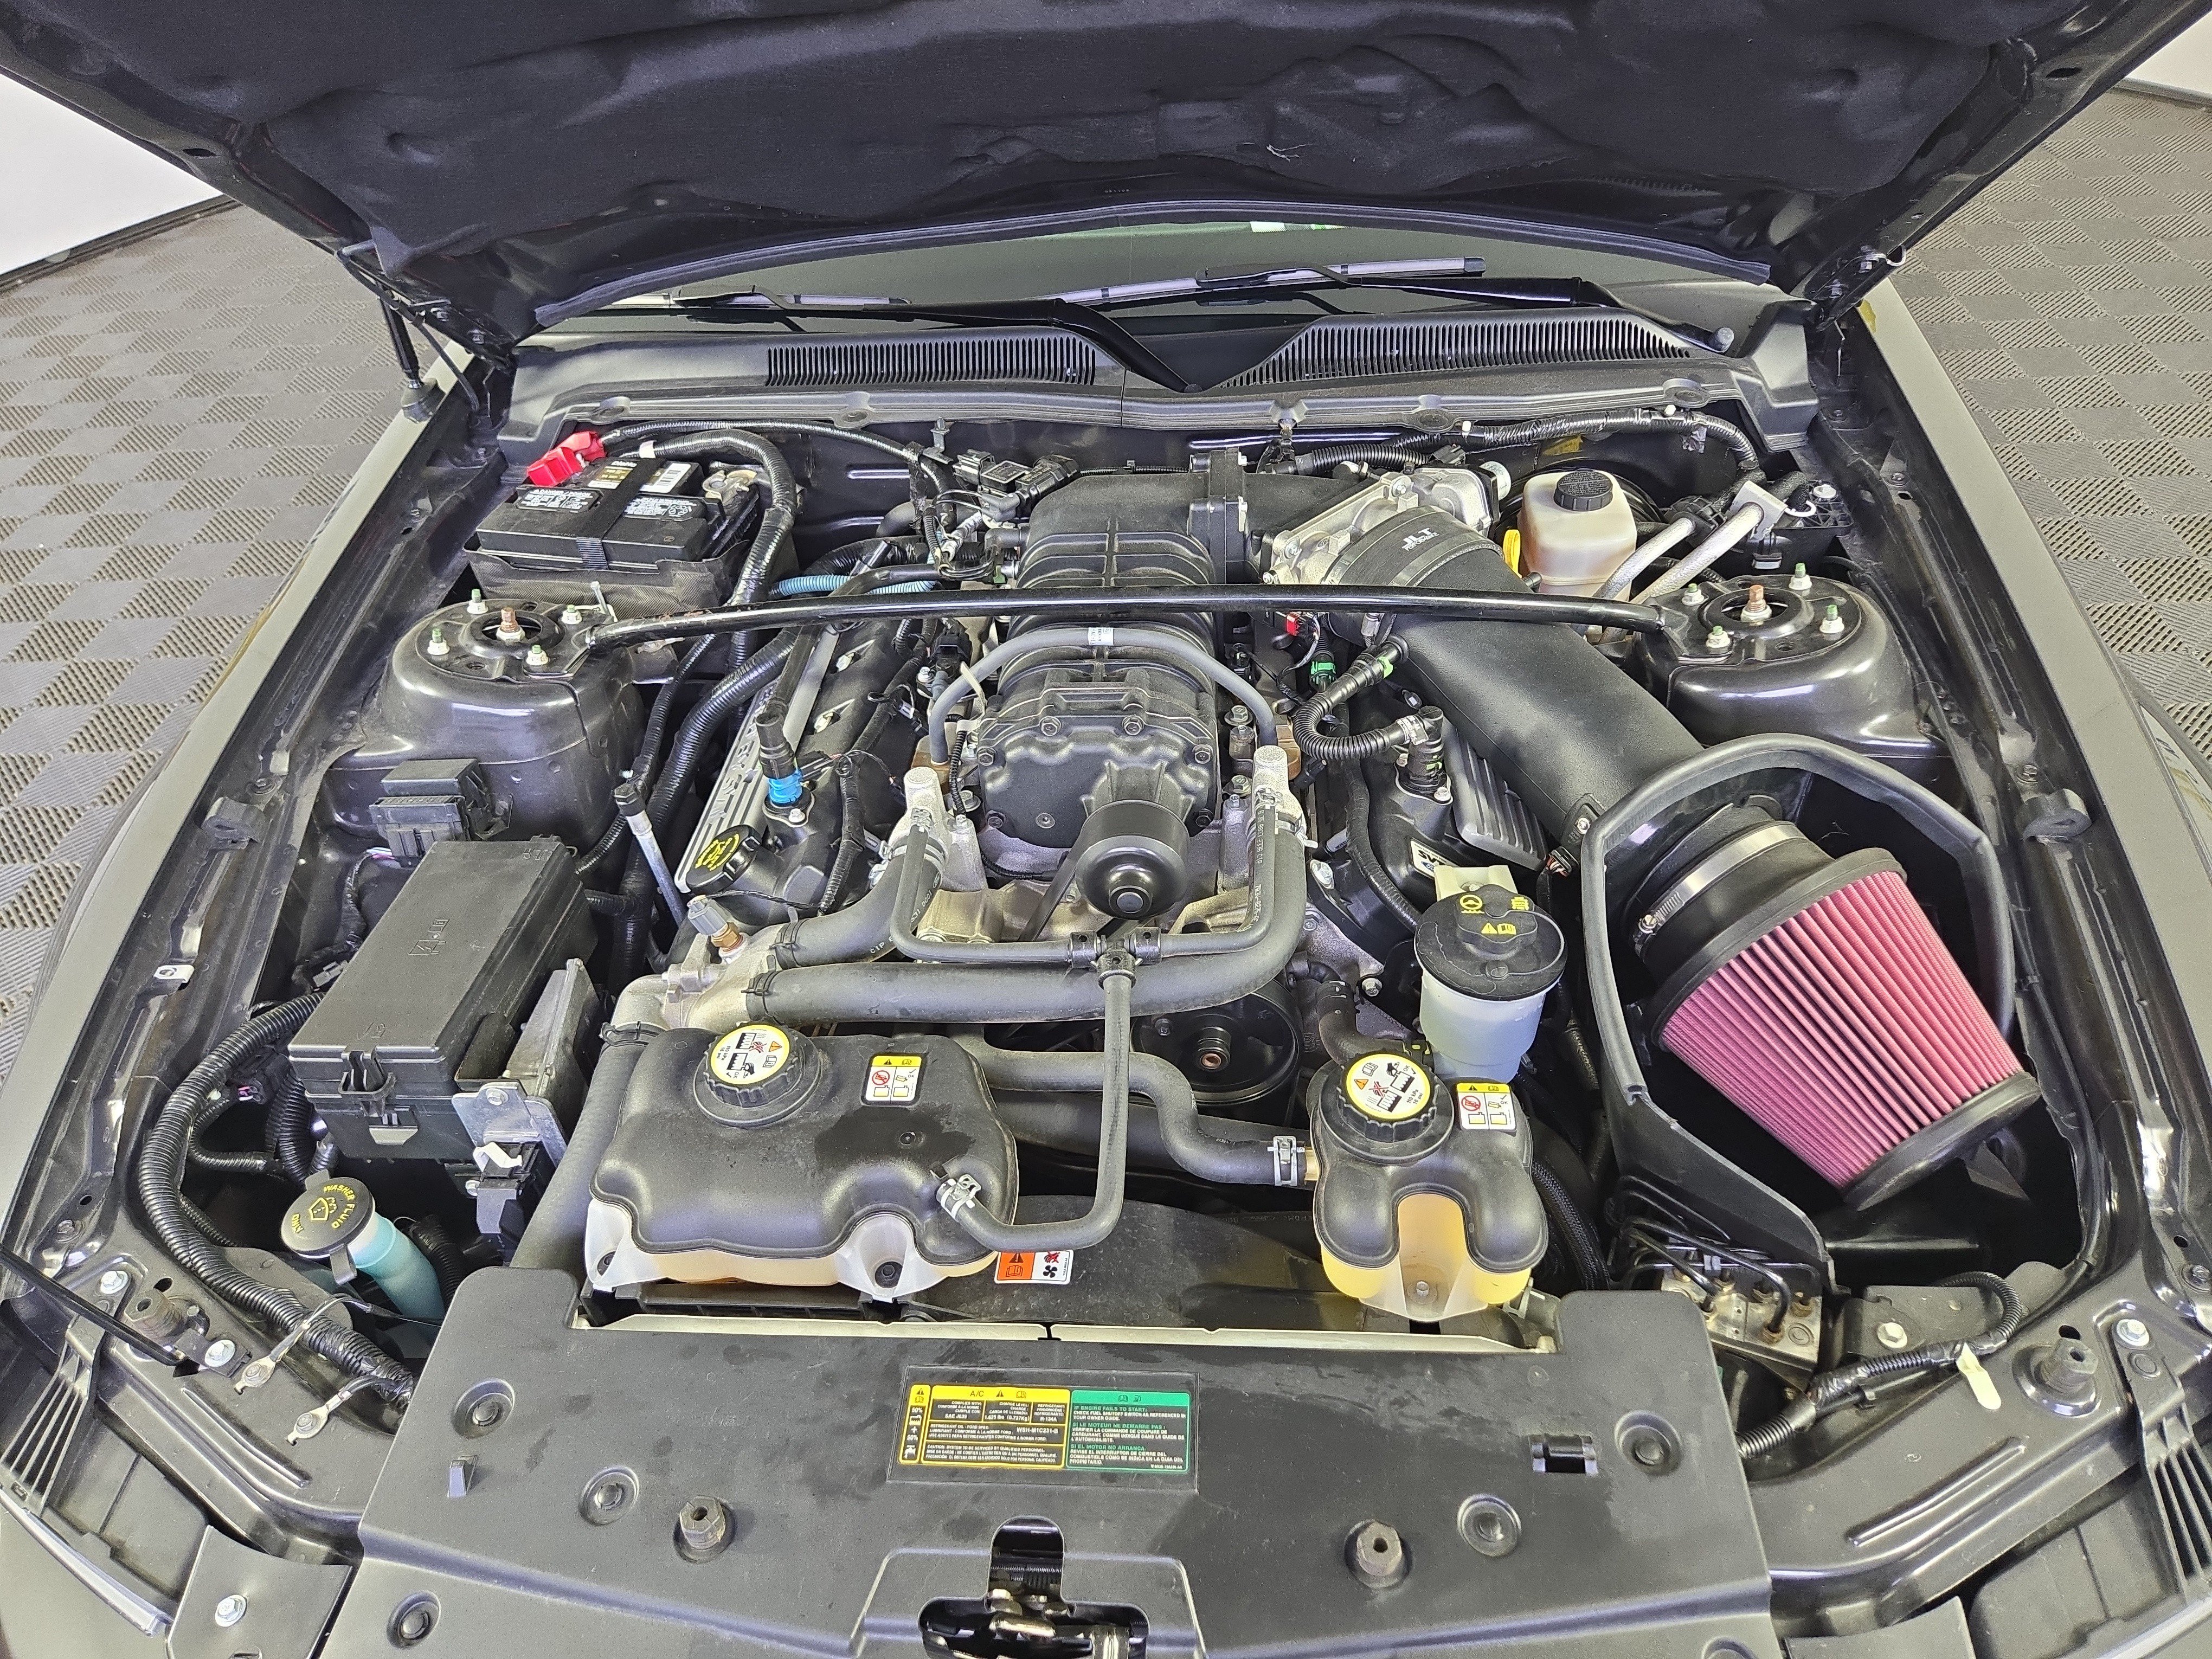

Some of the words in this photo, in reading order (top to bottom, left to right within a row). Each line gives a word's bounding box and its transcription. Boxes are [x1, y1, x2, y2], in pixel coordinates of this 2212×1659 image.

[1401, 528, 1432, 549] JLT
[870, 942, 885, 954] CIP
[1411, 1089, 1419, 1097] kPa
[324, 1184, 355, 1200] WASHER
[292, 1213, 304, 1233] ONLY
[331, 1204, 356, 1229] FLUID
